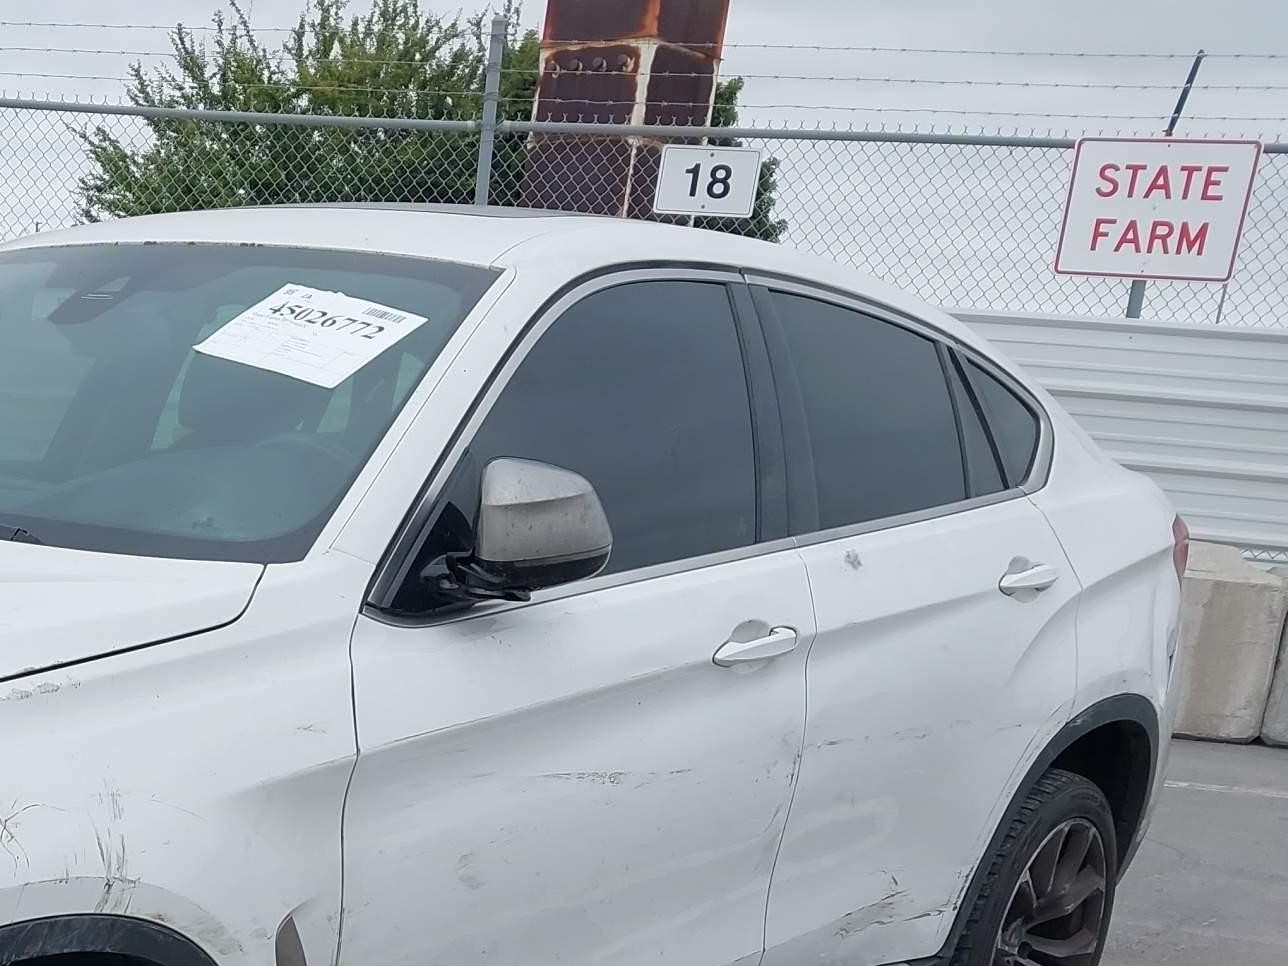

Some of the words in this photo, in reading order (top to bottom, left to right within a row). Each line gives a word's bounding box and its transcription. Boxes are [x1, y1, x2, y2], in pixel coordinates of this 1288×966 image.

[685, 162, 733, 200] 18
[1096, 162, 1230, 203] STATE
[1089, 217, 1212, 257] FARM
[268, 300, 386, 340] 45026772
